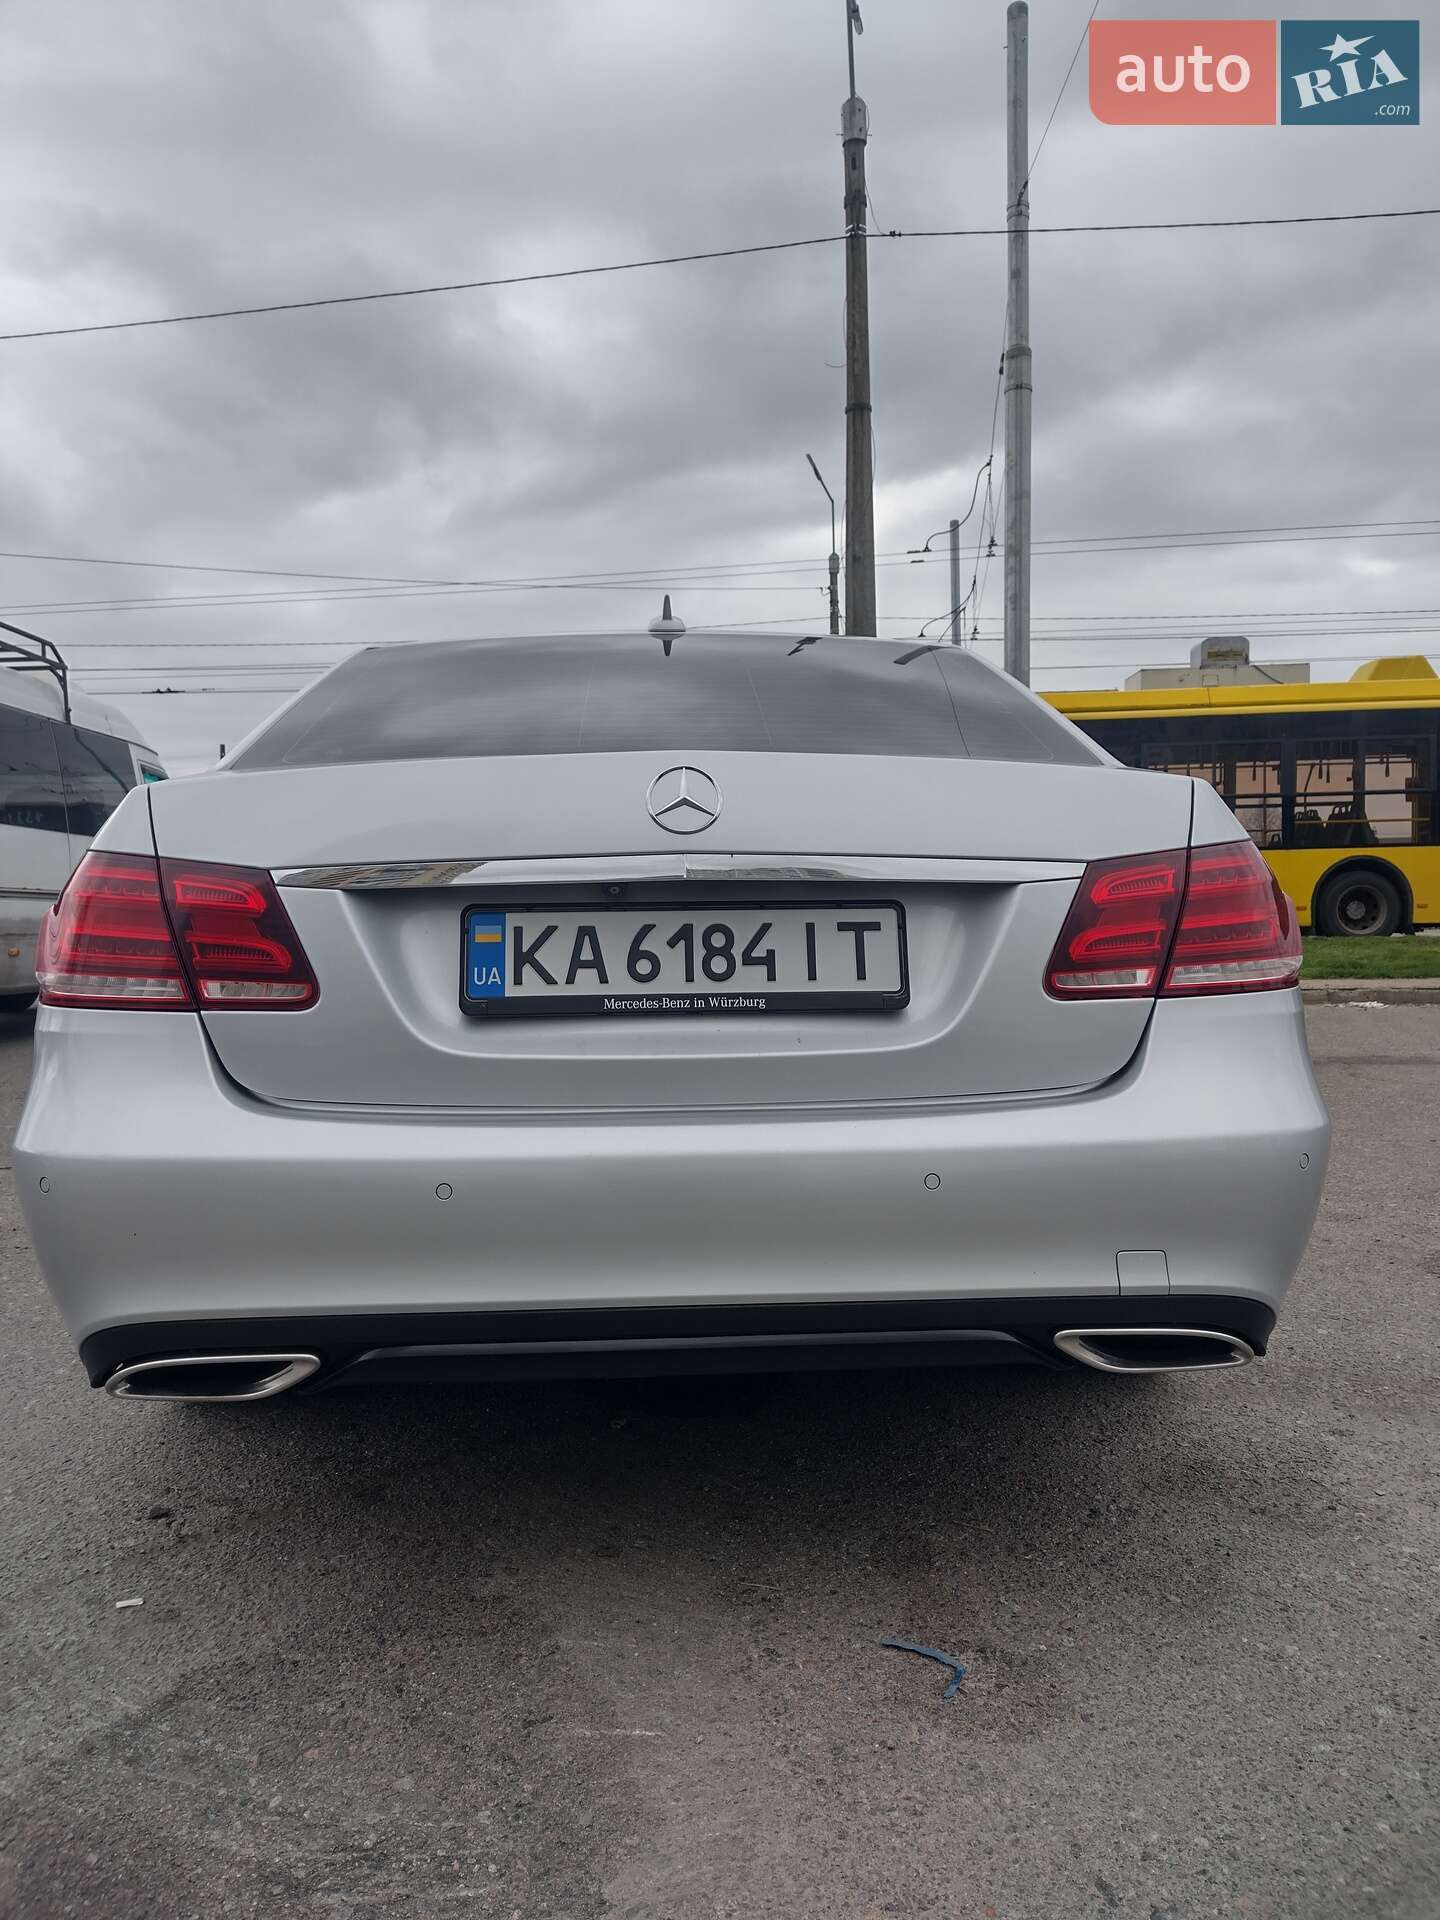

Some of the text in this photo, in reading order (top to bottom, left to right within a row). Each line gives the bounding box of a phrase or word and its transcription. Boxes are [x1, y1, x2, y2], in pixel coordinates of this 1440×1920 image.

[513, 921, 882, 985] KA 6184 IT
[474, 967, 502, 985] UA
[603, 996, 767, 1010] Mercedes-Benz in Würzburg
